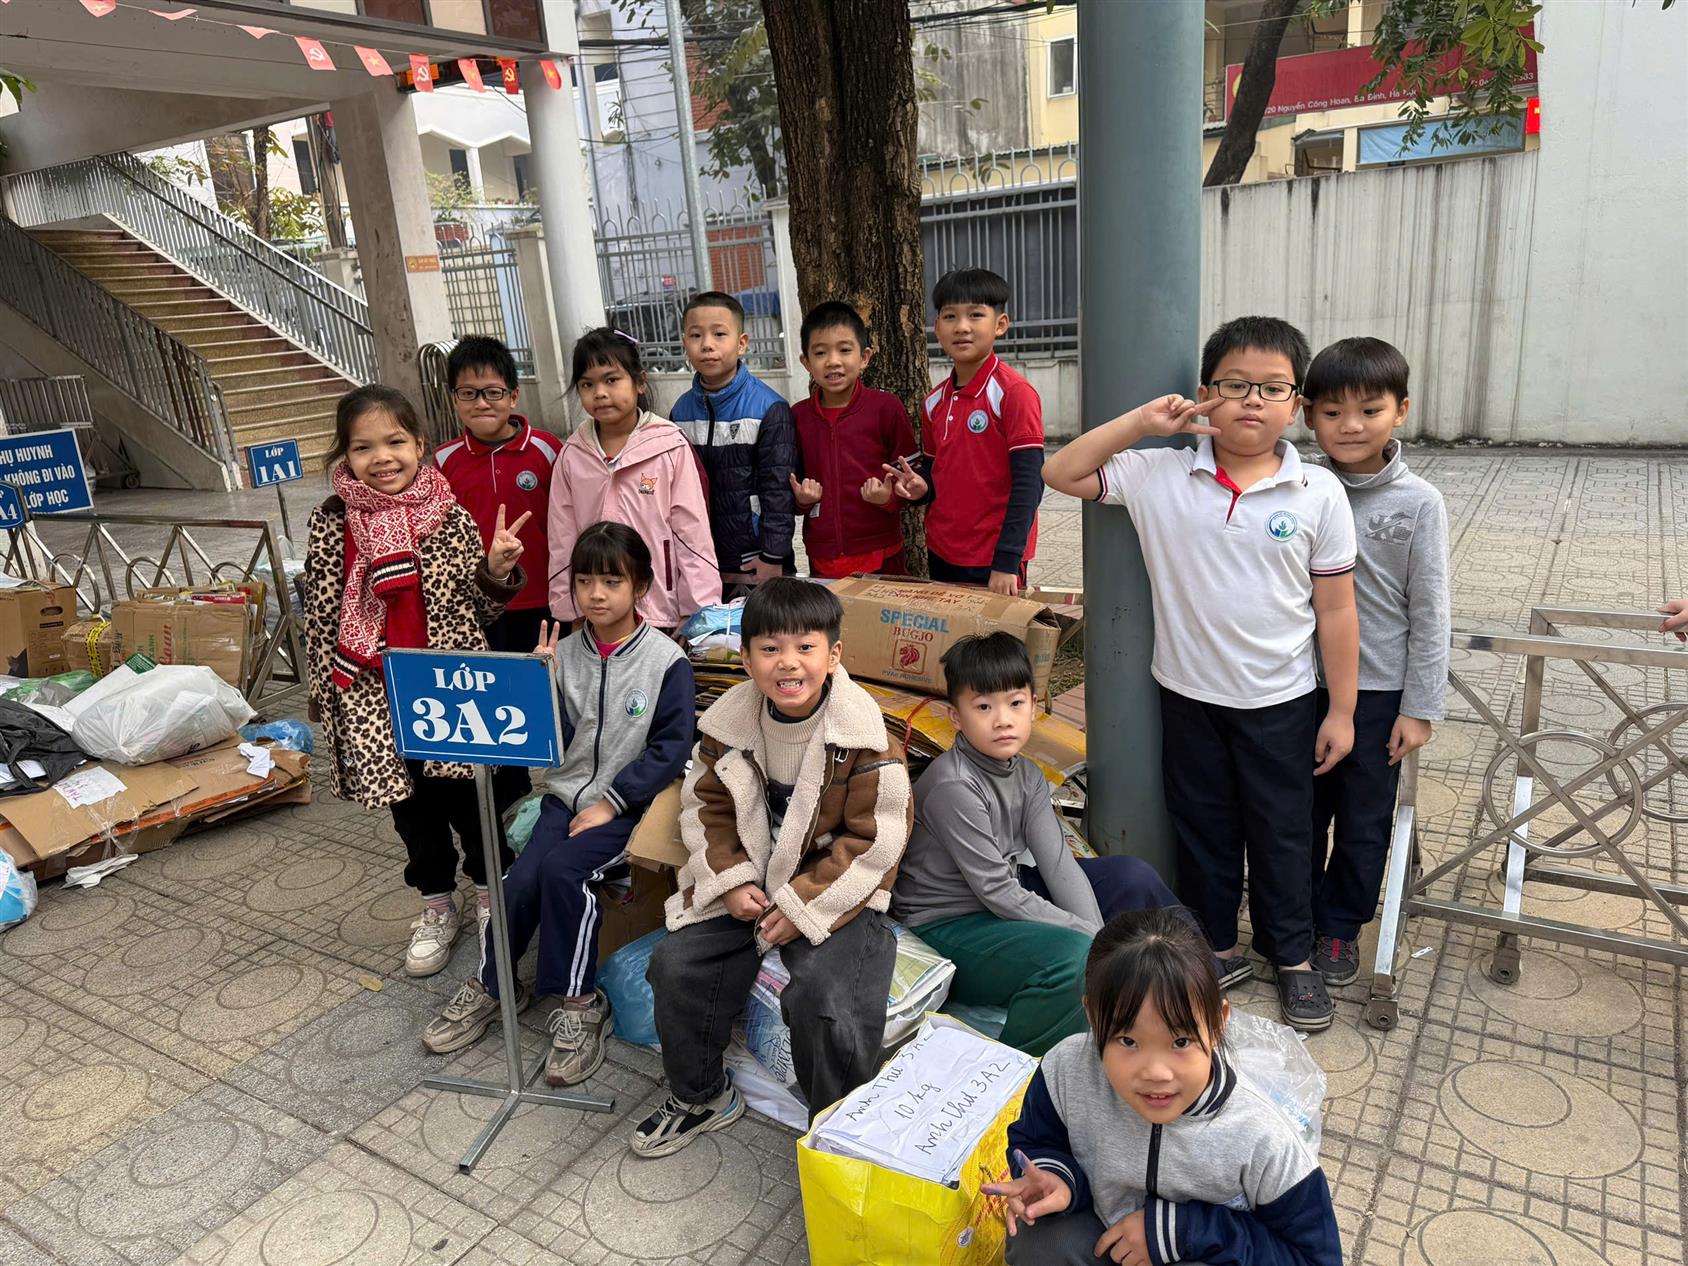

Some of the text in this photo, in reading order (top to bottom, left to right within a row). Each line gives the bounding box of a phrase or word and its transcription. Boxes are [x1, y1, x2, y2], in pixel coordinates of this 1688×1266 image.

[1330, 97, 1352, 105] Hoan,
[15, 444, 53, 462] HUYNH
[265, 444, 284, 458] LỚP
[4, 462, 76, 486] KHÔNG ĐI VÀO
[258, 460, 297, 483] 1A1
[24, 490, 44, 509] LỚP
[46, 488, 69, 507] HỌC
[880, 608, 950, 633] SPECIAL
[893, 626, 934, 642] BUGJO
[432, 662, 496, 692] LỚP
[412, 697, 529, 746] 3A2
[894, 1081, 942, 1120] 10 kg
[914, 1120, 953, 1156] Anh
